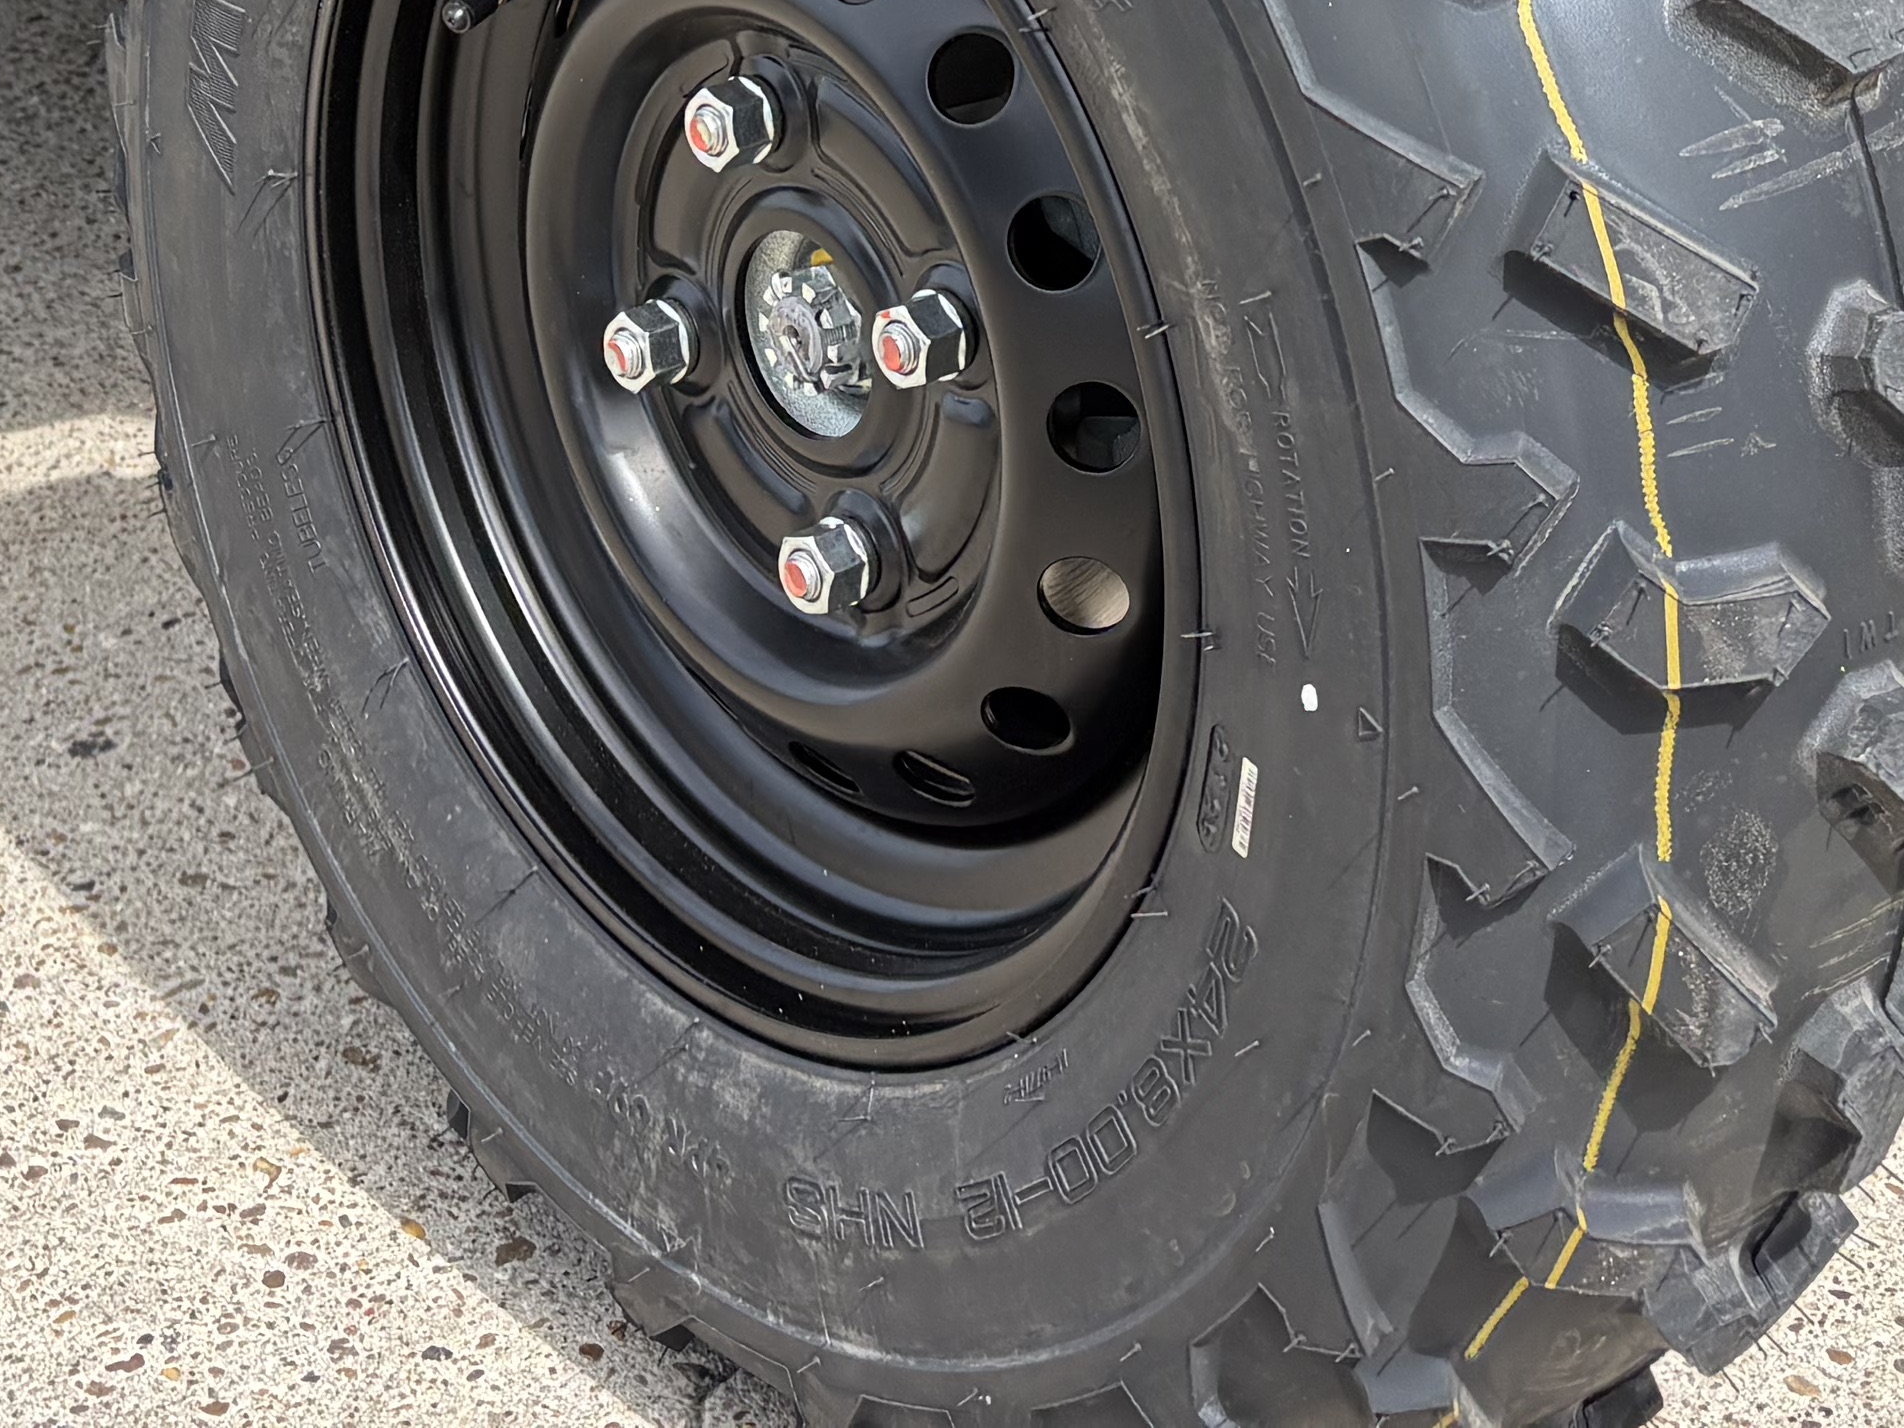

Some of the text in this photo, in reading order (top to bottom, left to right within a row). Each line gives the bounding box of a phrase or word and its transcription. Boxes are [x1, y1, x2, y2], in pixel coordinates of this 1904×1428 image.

[1264, 396, 1312, 559] ROTATION
[784, 896, 1259, 1251] 24X8.00-12 NHS
